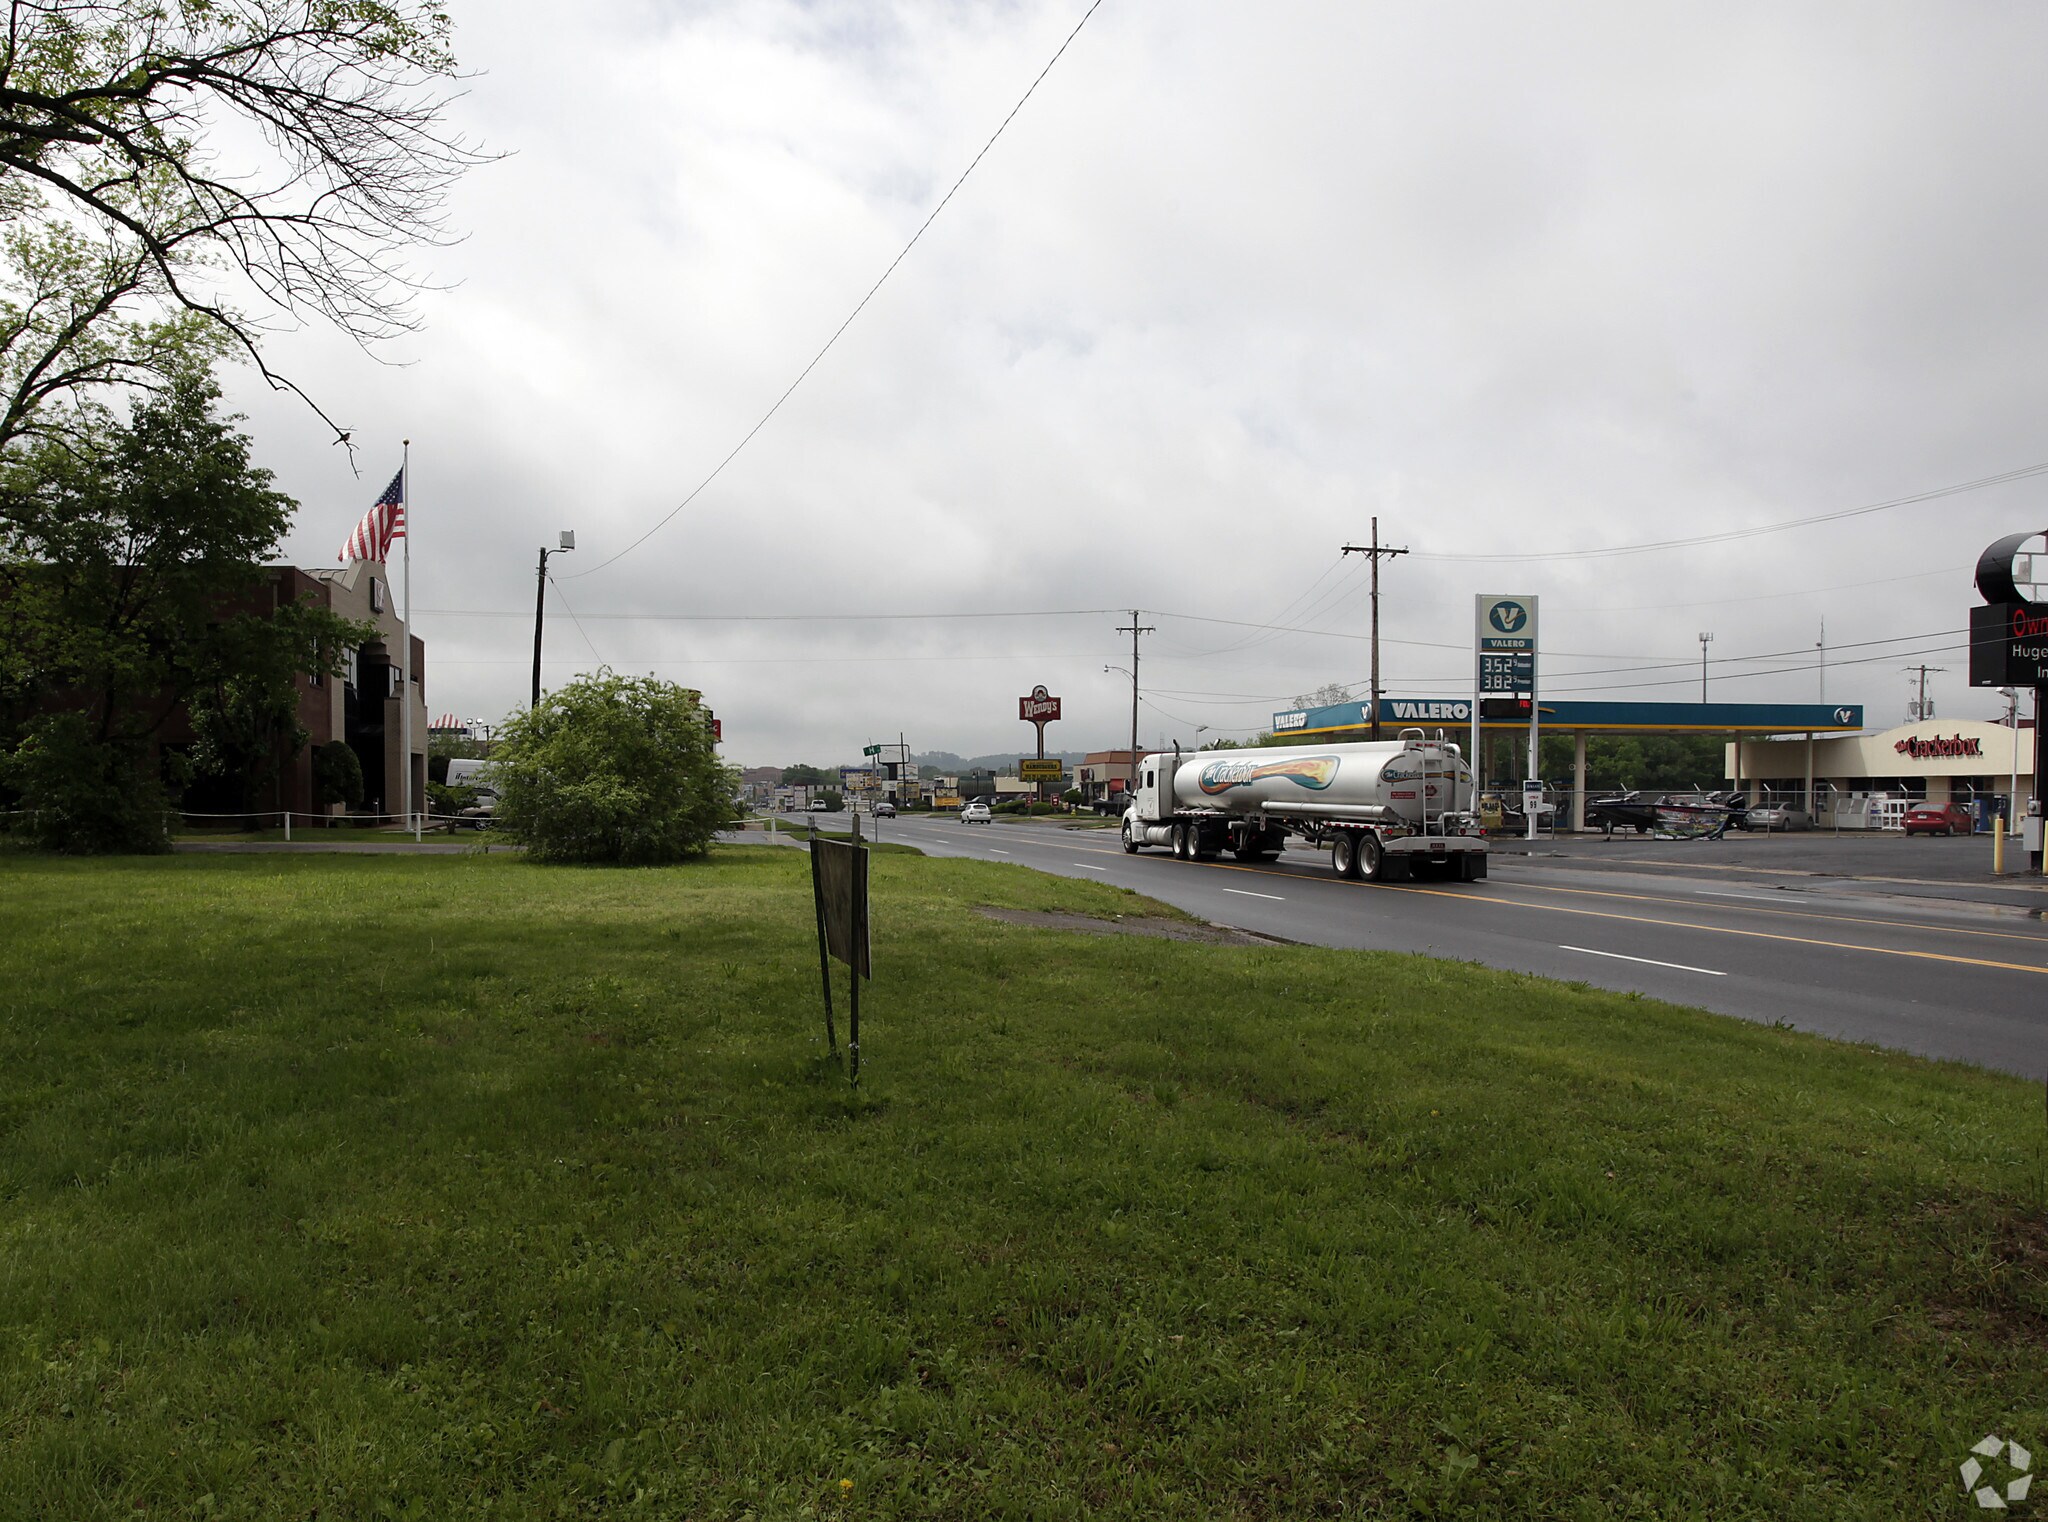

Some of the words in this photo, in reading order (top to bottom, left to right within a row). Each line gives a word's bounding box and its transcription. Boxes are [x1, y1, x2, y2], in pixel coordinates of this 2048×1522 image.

[1490, 639, 1526, 648] VALERO
[2012, 644, 2048, 661] Huge
[1391, 702, 1469, 720] VALERO
[1274, 712, 1307, 729] VALERO
